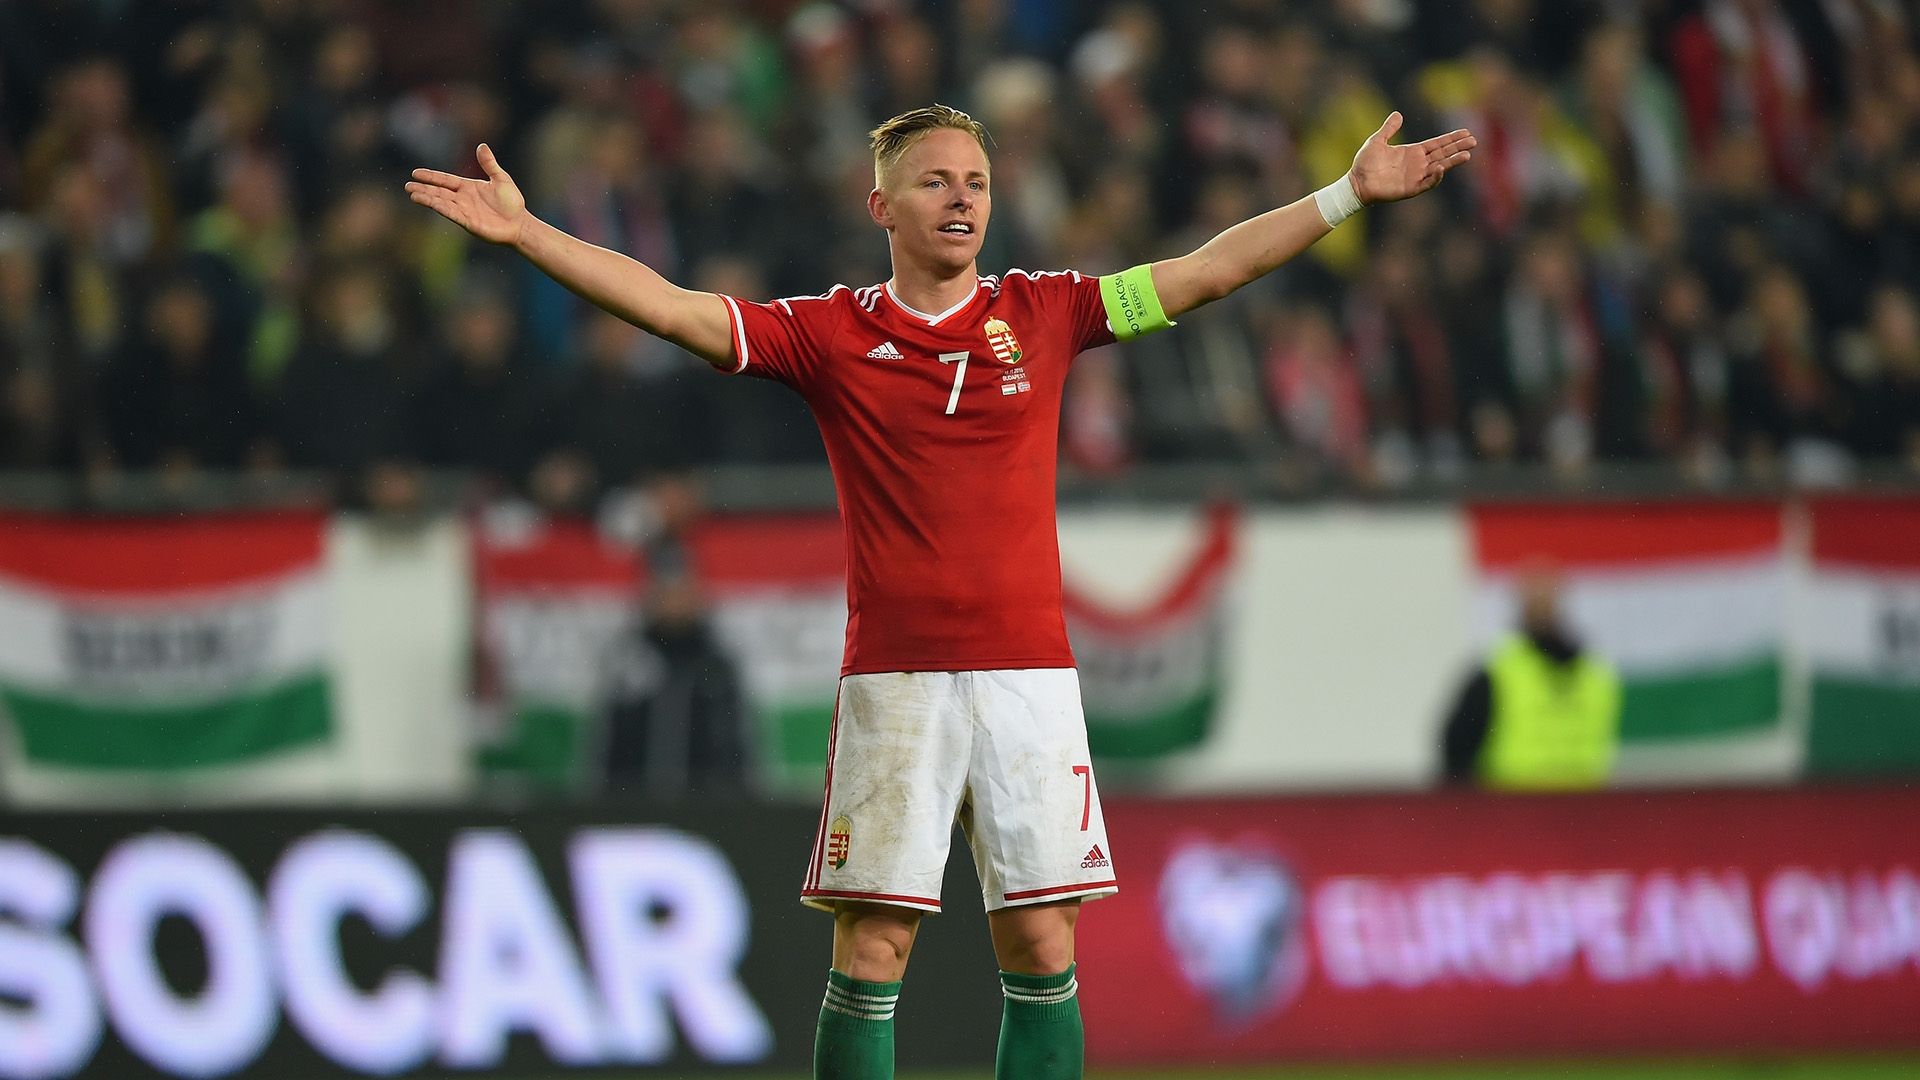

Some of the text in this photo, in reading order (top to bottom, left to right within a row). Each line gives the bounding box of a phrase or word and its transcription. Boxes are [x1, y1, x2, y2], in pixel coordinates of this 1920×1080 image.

[1129, 283, 1142, 310] RESPECT
[1124, 309, 1135, 323] TO
[866, 351, 905, 360] adidas
[938, 351, 970, 415] 7
[1002, 373, 1026, 382] BUDAPEST
[1072, 765, 1091, 831] 7
[1081, 858, 1109, 869] adidas
[1312, 872, 1758, 989] EUROPEAN
[0, 830, 770, 1077] SOCAR
